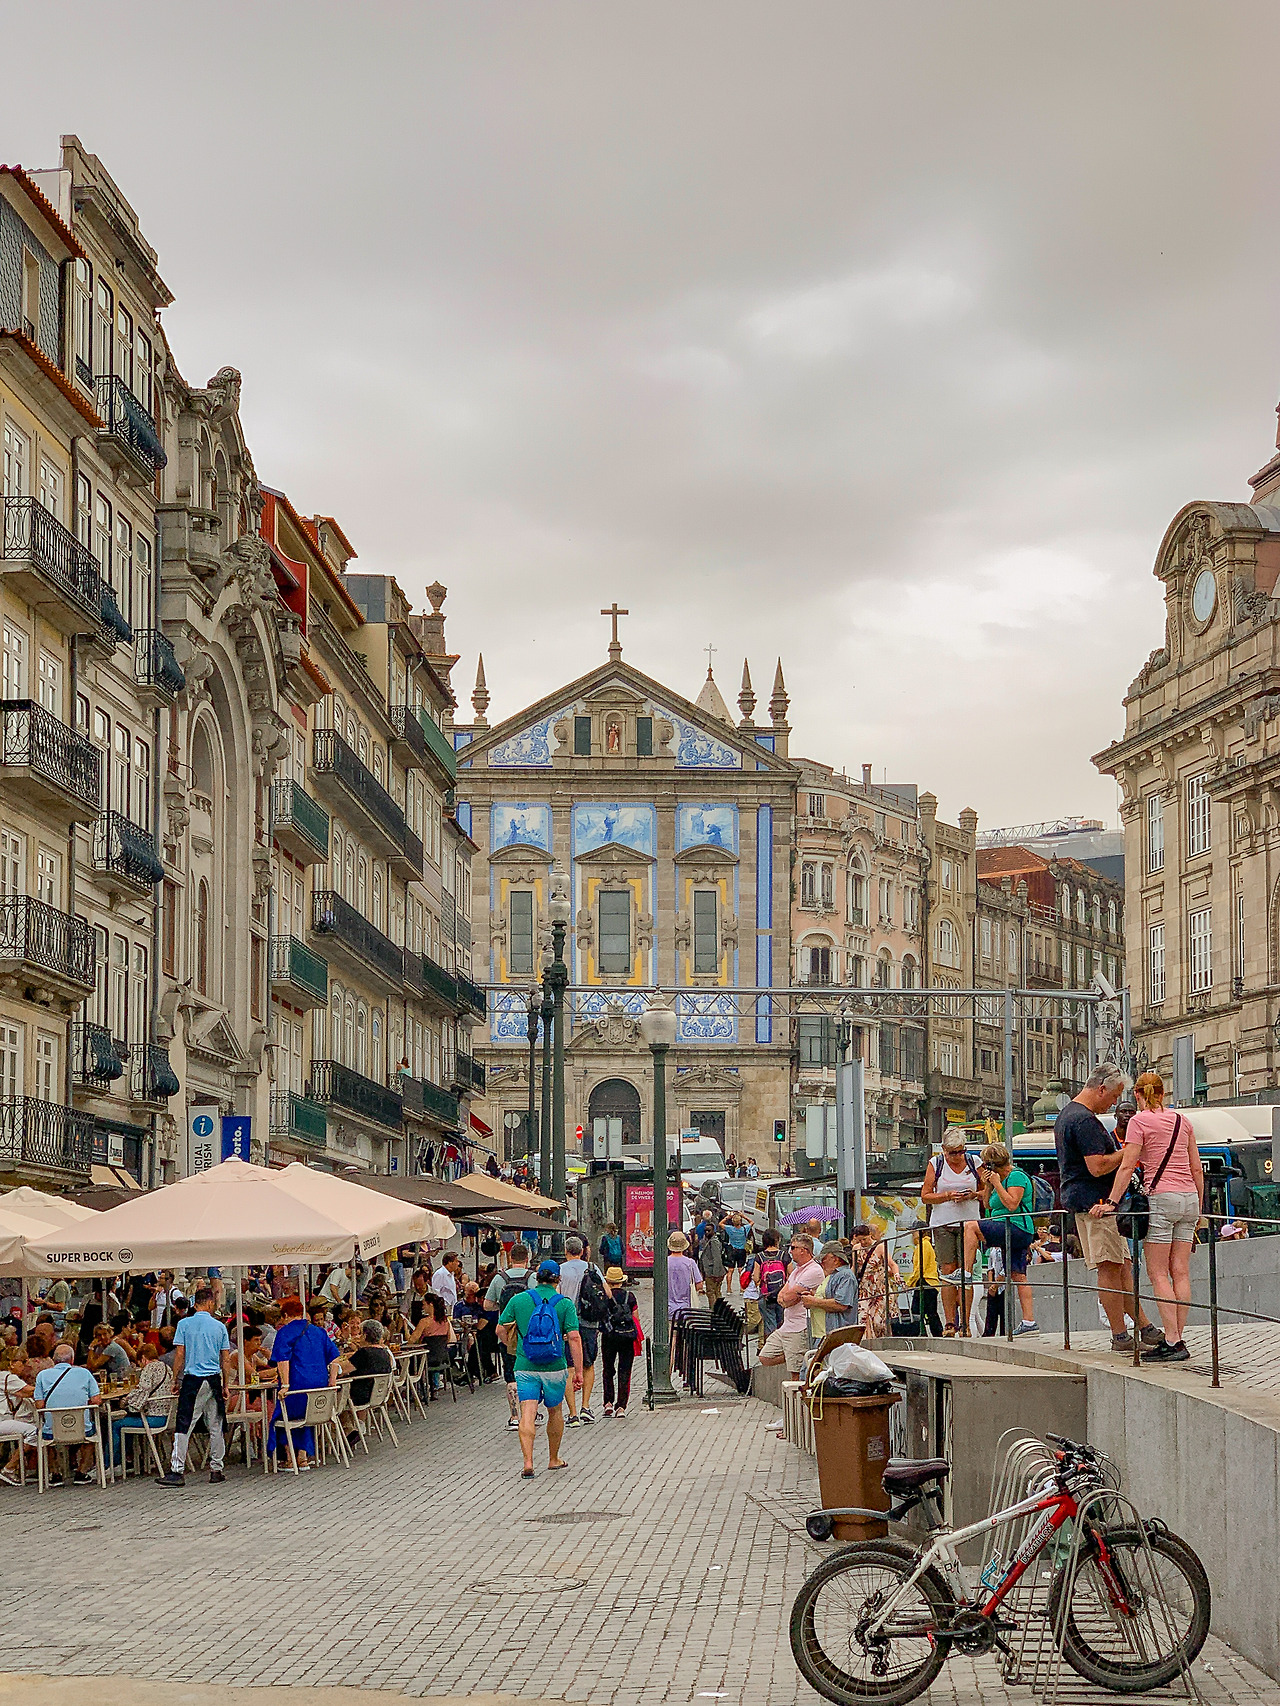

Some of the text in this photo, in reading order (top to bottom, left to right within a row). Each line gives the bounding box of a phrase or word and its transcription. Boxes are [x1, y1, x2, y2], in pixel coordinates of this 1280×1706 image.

[232, 1126, 242, 1155] orto.
[194, 1143, 203, 1175] FICIAL
[203, 1143, 212, 1171] RISM
[46, 1252, 81, 1263] SUPER
[83, 1251, 114, 1262] BOCK
[1021, 1523, 1054, 1564] DECATHLON
